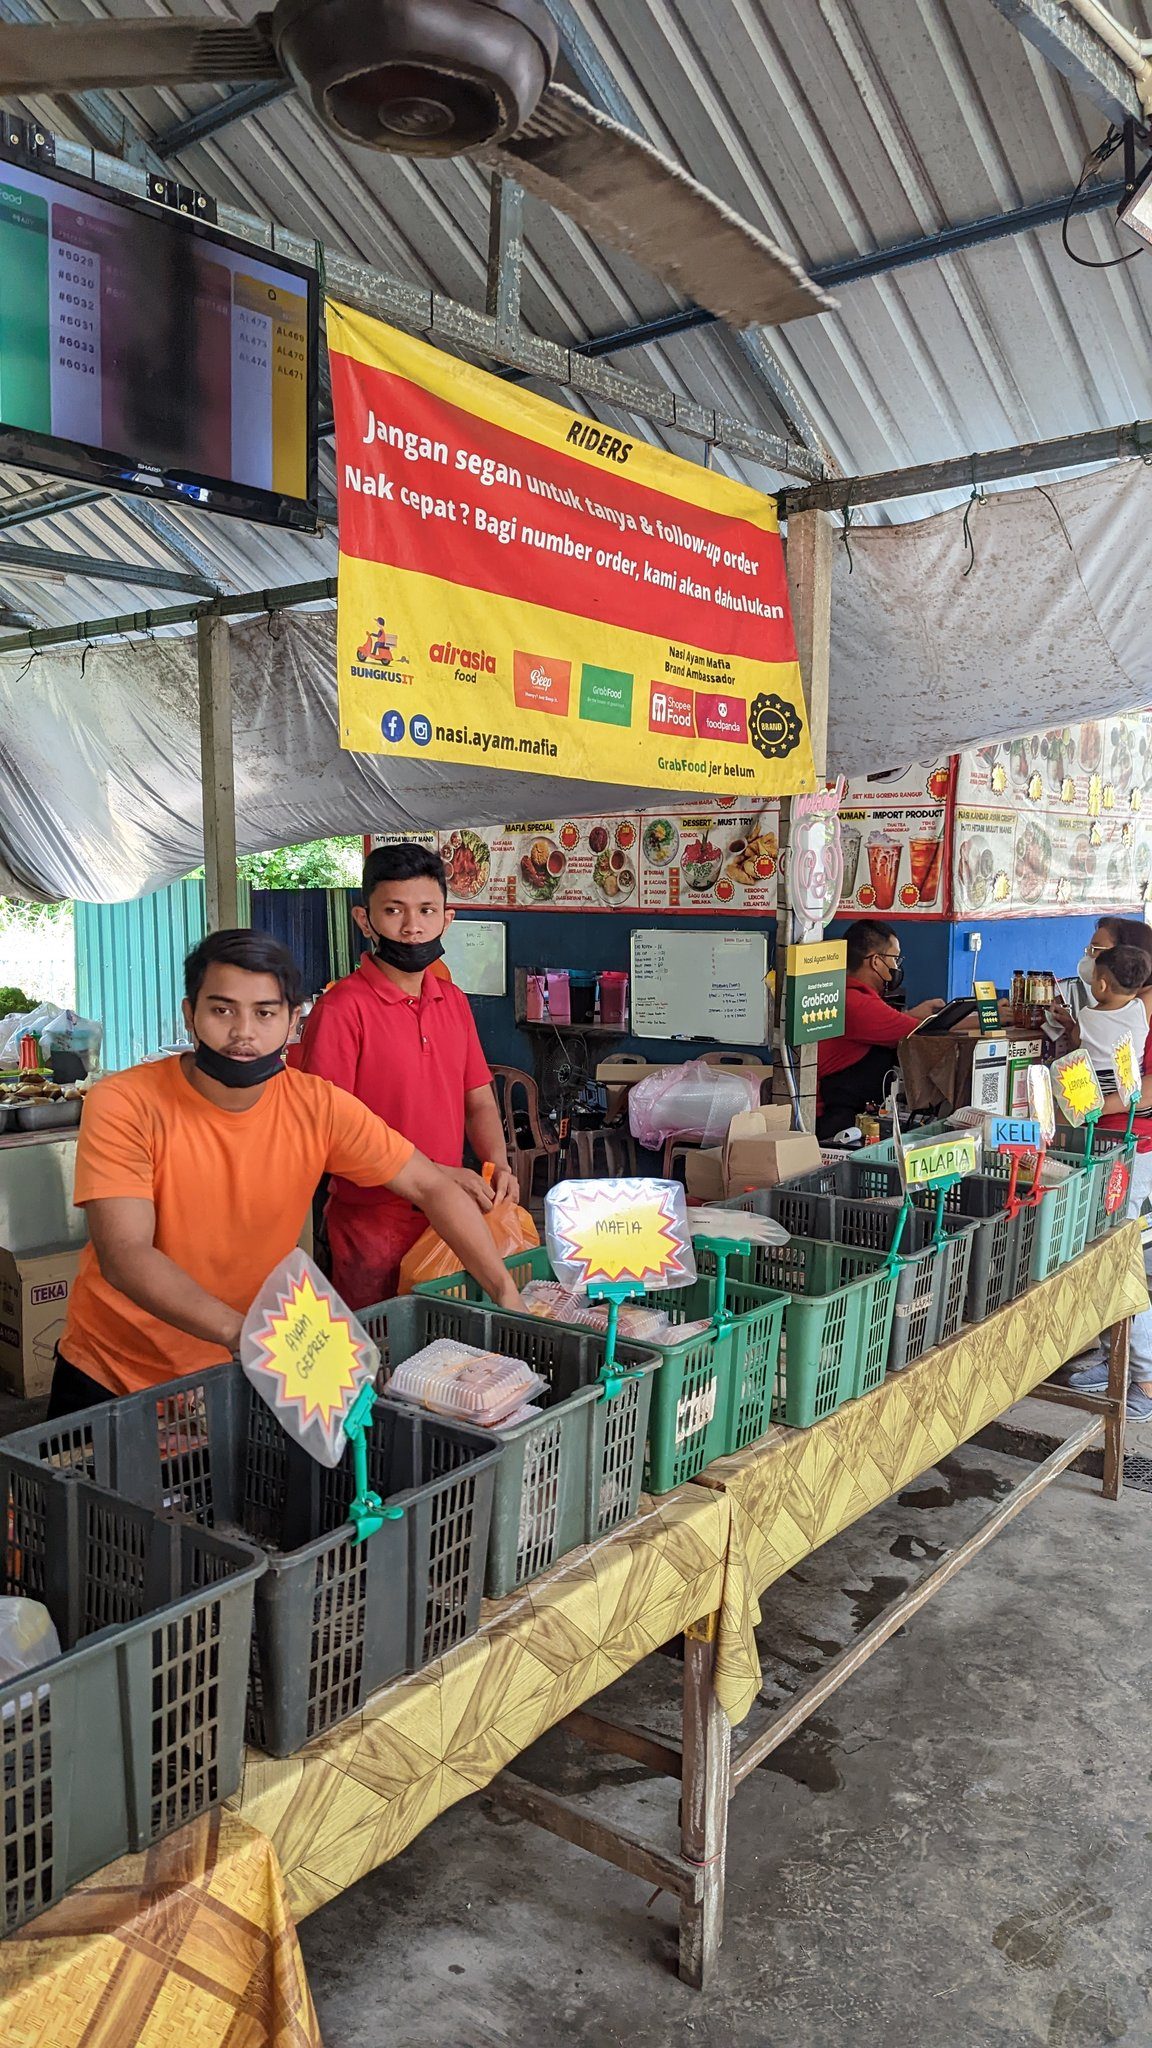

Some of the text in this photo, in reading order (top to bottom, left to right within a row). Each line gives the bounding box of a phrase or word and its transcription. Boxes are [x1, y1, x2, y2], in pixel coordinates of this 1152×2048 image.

[565, 420, 634, 465] RIDERS
[137, 463, 161, 473] SHARP
[363, 410, 759, 576] Jangan segan untuk tanya & follow-up order
[345, 464, 784, 619] Nak cepat ? Bagi number order, kami akan dahulukan
[429, 641, 497, 674] airasia
[669, 646, 731, 670] Nasi Ayam Mafia
[350, 665, 414, 686] BUNGKUSIT
[454, 668, 477, 684] food
[530, 669, 552, 691] Beep
[664, 661, 736, 685] Brand Ambassador
[592, 686, 622, 699] GrabFood
[667, 697, 691, 711] Shopee
[667, 708, 691, 726] Food
[706, 718, 741, 733] foodpanda
[761, 722, 782, 731] BRAND
[435, 724, 558, 757] nasi.ayam.mafia
[657, 756, 755, 778] GrabFood jer belum
[683, 819, 712, 827] DESSERT
[873, 811, 904, 819] IMPORT
[905, 809, 944, 818] PRODUCT
[505, 823, 554, 832] MAFIA SPECIAL
[814, 956, 826, 965] Ayam
[827, 953, 839, 961] Mafia
[802, 990, 839, 1008] GrabFood
[996, 1123, 1036, 1143] KELI
[910, 1149, 970, 1177] TALAPIA
[596, 1221, 642, 1235] MAFIA
[34, 1285, 64, 1302] TEKA
[296, 1329, 330, 1379] GEPREK
